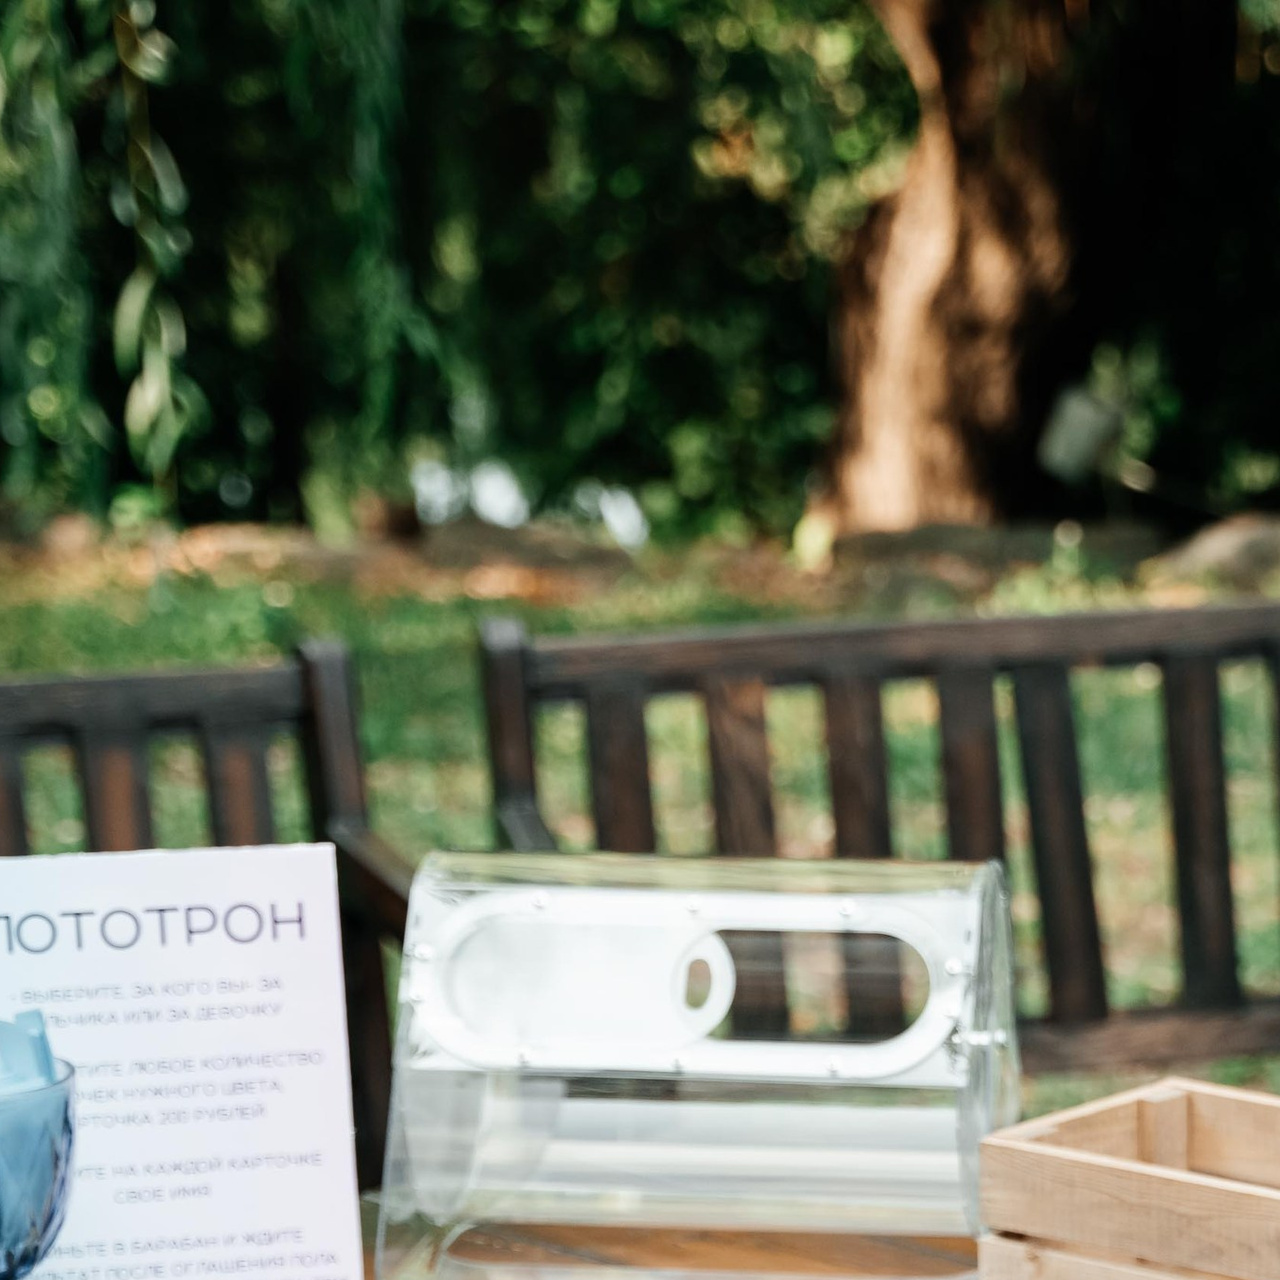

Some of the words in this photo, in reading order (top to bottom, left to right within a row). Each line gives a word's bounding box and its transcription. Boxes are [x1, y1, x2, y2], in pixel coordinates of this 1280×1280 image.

[130, 982, 154, 999] ЗА
[160, 979, 213, 997] КОГО
[257, 975, 282, 992] ЗА
[166, 1006, 190, 1022] ЗА
